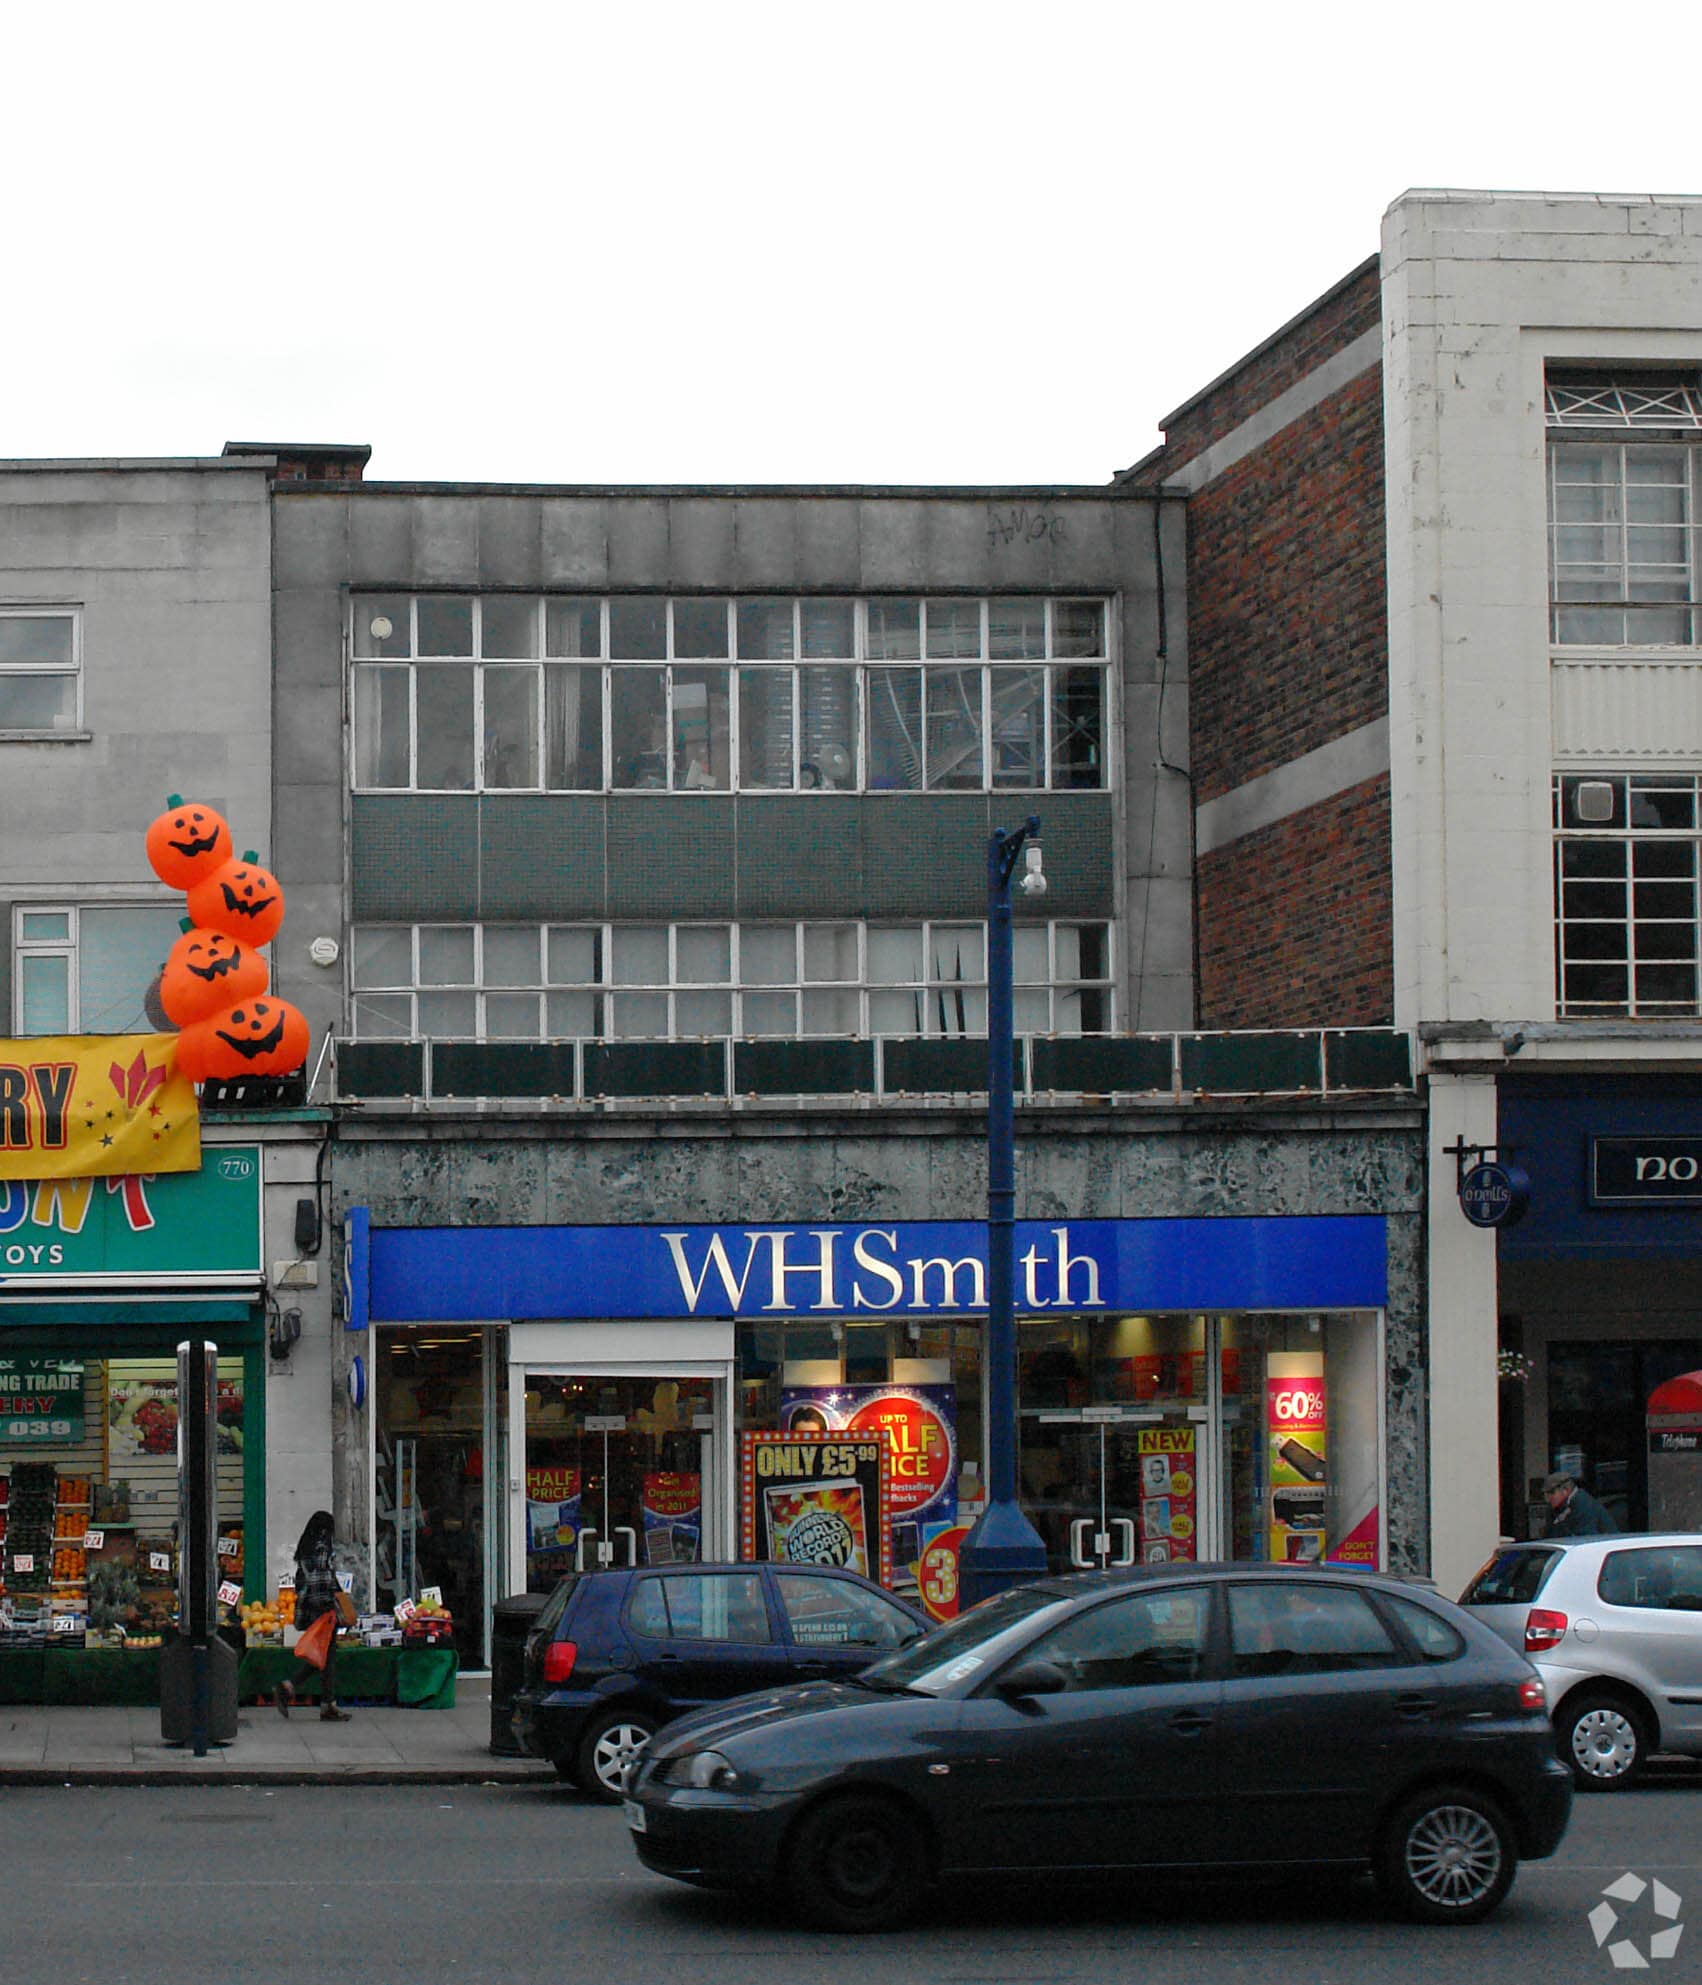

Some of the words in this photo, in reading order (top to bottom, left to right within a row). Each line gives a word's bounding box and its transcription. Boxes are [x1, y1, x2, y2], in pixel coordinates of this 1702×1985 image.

[222, 1161, 250, 1175] 770
[0, 1244, 64, 1265] OYS
[659, 1227, 1106, 1312] WHSmth
[24, 1374, 80, 1391] TRADE
[1275, 1390, 1324, 1420] 60%
[9, 1421, 71, 1436] 039
[880, 1415, 893, 1424] UP
[895, 1415, 907, 1423] TO
[1142, 1431, 1191, 1450] NEW
[757, 1446, 819, 1477] ONLY
[890, 1455, 930, 1477] ICE
[527, 1471, 574, 1487] HALF
[531, 1487, 570, 1499] PRICE
[789, 1520, 845, 1553] WORLD
[791, 1528, 851, 1562] RECORDS
[925, 1548, 956, 1604] 3
